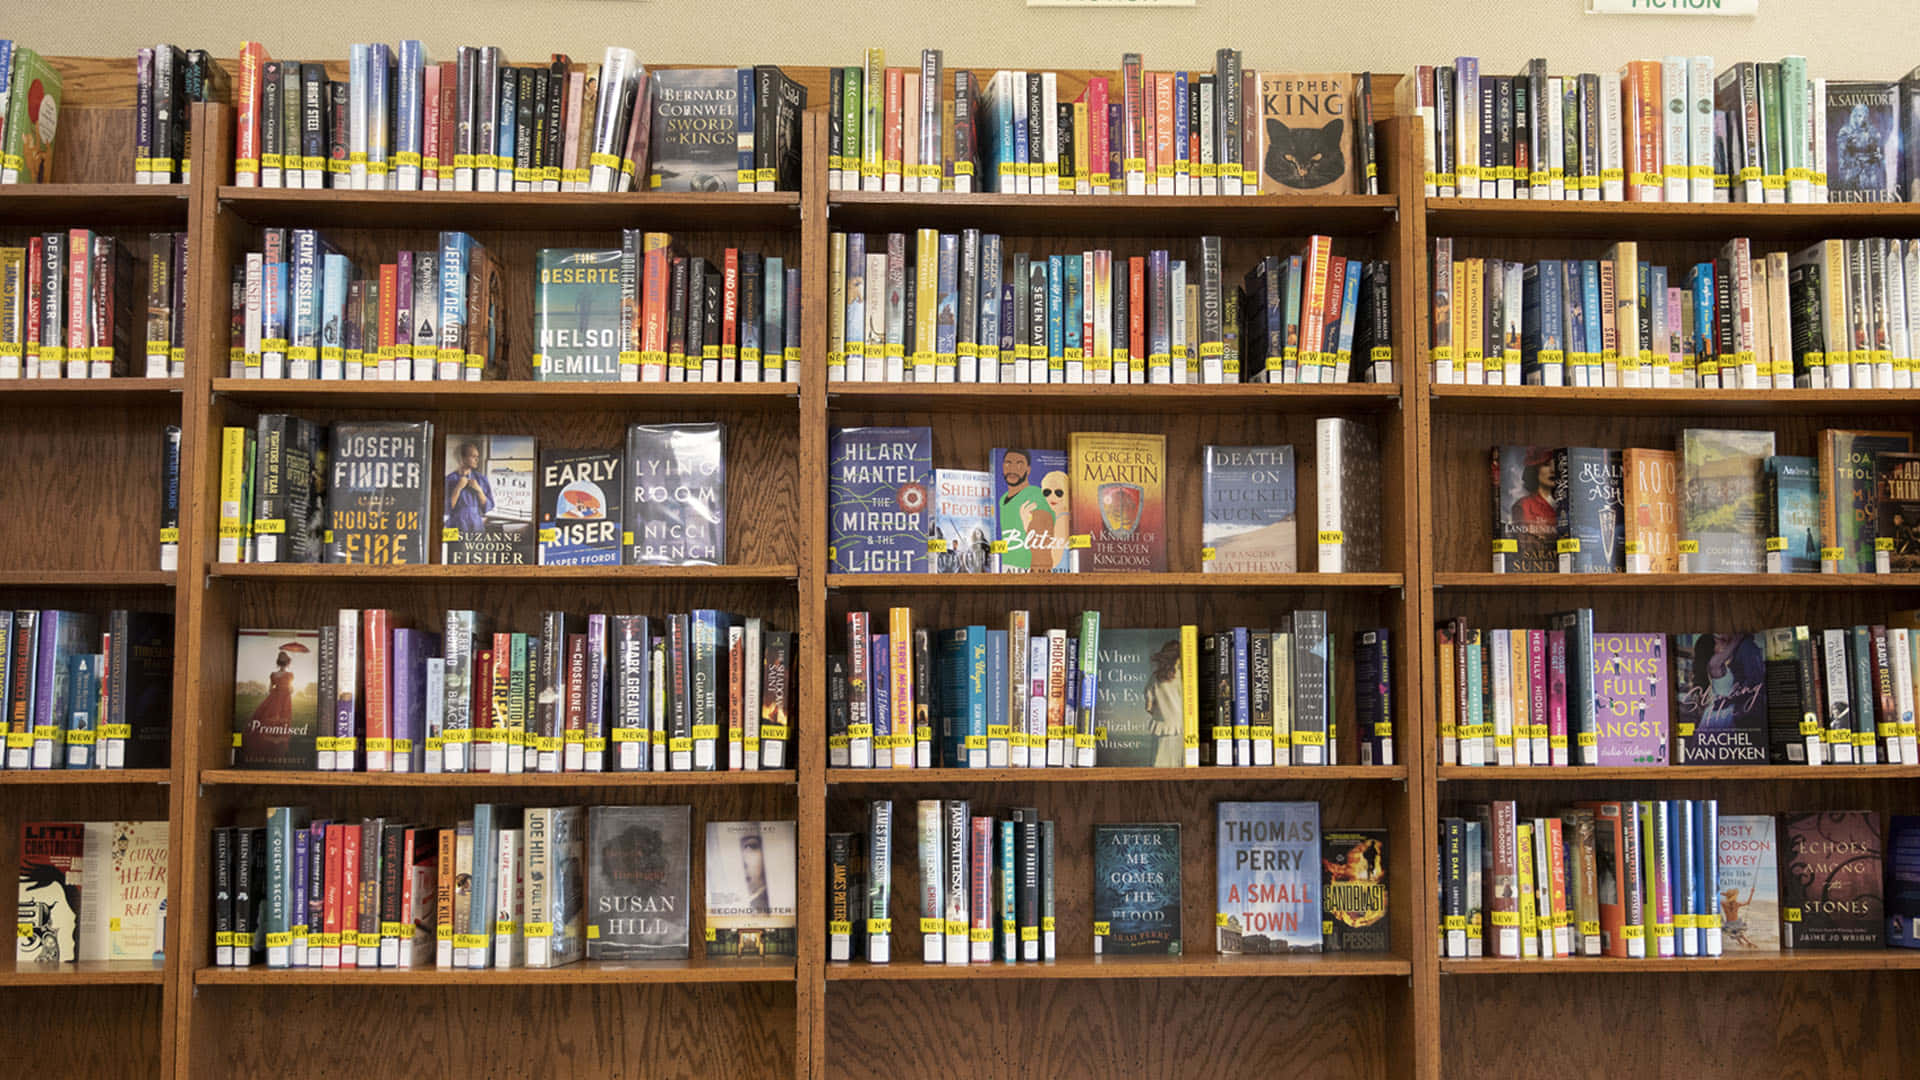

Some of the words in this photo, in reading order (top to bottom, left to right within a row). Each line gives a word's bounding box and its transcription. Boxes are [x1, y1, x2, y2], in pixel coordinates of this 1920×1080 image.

[1031, 77, 1040, 91] The
[1157, 77, 1169, 110] MEG
[1263, 81, 1343, 92] STEPHEN
[307, 82, 318, 107] BRIGHT
[664, 88, 736, 101] BERNARD
[1031, 93, 1042, 133] Midnight
[1227, 102, 1235, 123] KIDD
[1263, 94, 1344, 116] KING
[308, 110, 319, 130] STEEL
[668, 118, 734, 132] SWORD
[679, 132, 735, 145] KINGS
[1032, 137, 1040, 157] Hour
[47, 237, 57, 269] DEAD
[300, 235, 313, 264] CLIVE
[444, 246, 460, 293] JEFFERY
[1205, 248, 1219, 275] JEFF
[4, 265, 16, 290] JAMES
[47, 274, 57, 287] TO
[541, 268, 620, 284] DESERTE
[726, 269, 735, 286] END
[1334, 262, 1343, 283] LOST
[299, 267, 312, 315] CUSSLER
[1603, 266, 1614, 315] REPUTATION
[47, 291, 57, 319] HER
[726, 288, 735, 321] GAME
[1033, 286, 1043, 320] SEVEN
[1206, 279, 1219, 334] LINDSAY
[444, 297, 460, 342] DEAVER
[1470, 287, 1478, 340] WONDERFUL
[540, 328, 620, 348] NELSO
[1034, 325, 1044, 346] DAY
[341, 436, 415, 458] JOSEPH
[845, 443, 918, 461] HILARY
[1085, 450, 1132, 463] GEORGE
[635, 459, 714, 476] LYING
[1216, 452, 1284, 465] DEATH
[334, 462, 420, 489] FINDER
[544, 459, 619, 488] EARLY
[842, 466, 920, 484] MANTEL
[1084, 464, 1158, 483] MARTIN
[1251, 471, 1280, 483] ON
[269, 475, 278, 494] FEAR
[941, 483, 991, 497] SHIELD
[634, 486, 715, 503] ROOM
[872, 497, 891, 507] THE
[941, 501, 994, 517] PEOPLE
[333, 511, 391, 530] HOUSE
[396, 511, 418, 530] ON
[843, 512, 920, 531] MIRROR
[457, 531, 522, 542] SUZANNE
[547, 521, 615, 548] RISER
[644, 524, 705, 539] NICCI
[867, 535, 876, 545] &
[877, 535, 895, 545] THE
[1100, 530, 1140, 542] KNIGHT
[1320, 533, 1341, 541] NEW
[346, 533, 408, 565] FIRE
[465, 542, 513, 551] WOODS
[633, 545, 715, 560] FRENCH
[1097, 543, 1115, 553] THE
[1118, 543, 1149, 553] SEVEN
[453, 551, 524, 564] FISHER
[581, 552, 616, 563] FFORDE
[848, 550, 915, 572] LIGHT
[1093, 553, 1150, 566] KINGDOMS
[897, 640, 905, 670] TERRY
[1594, 638, 1653, 653] HOLLY
[1877, 637, 1887, 667] DEADLY
[627, 640, 639, 673] MARK
[1099, 650, 1140, 664] When
[1254, 639, 1262, 675] WILLIAM
[1594, 658, 1657, 673] BANKS
[577, 653, 585, 690] CHOSEN
[1051, 637, 1064, 698] CHOKEHOLD
[1261, 658, 1269, 694] PURSUIT
[774, 663, 785, 706] SHADOW
[1604, 679, 1647, 695] FULL
[510, 670, 523, 727] REVOLUTION
[575, 693, 584, 711] ONE
[590, 681, 598, 718] GRAHAM
[626, 678, 639, 729] GREANEY
[1535, 686, 1544, 721] HIDDEN
[1612, 701, 1639, 716] OF
[252, 720, 308, 736] Promised
[1595, 721, 1661, 737] ANGST
[1698, 732, 1752, 745] RACHEL
[1684, 747, 1717, 760] VAN
[1719, 747, 1765, 760] DYKEN
[530, 813, 544, 838] JOE
[876, 807, 888, 834] JAMES
[951, 808, 961, 839] JAMES
[1111, 834, 1162, 846] AFTER
[1225, 821, 1314, 842] THOMAS
[530, 840, 544, 867] HILL
[1799, 841, 1868, 854] ECHOES
[273, 838, 282, 880] QUEEN'S
[875, 837, 888, 882] PATTERSON
[1127, 853, 1148, 865] ME
[1236, 849, 1304, 871] PERRY
[1452, 857, 1460, 880] DARK
[1804, 863, 1865, 873] AMONG
[833, 863, 846, 889] JAMES
[951, 842, 962, 897] PATTERSON
[1110, 872, 1164, 884] COMES
[273, 883, 282, 920] SECRET
[439, 886, 449, 903] THE
[1124, 892, 1155, 903] THE
[1228, 884, 1240, 903] A
[1248, 884, 1312, 903] SMALL
[1323, 884, 1385, 912] SANDBLAST
[600, 896, 675, 913] SUSAN
[833, 891, 847, 922] PATTERS
[1804, 900, 1869, 914] STONES
[439, 905, 449, 925] KILL
[1112, 910, 1165, 922] FLOOD
[1242, 912, 1298, 931] TOWN
[608, 918, 669, 935] HILL
